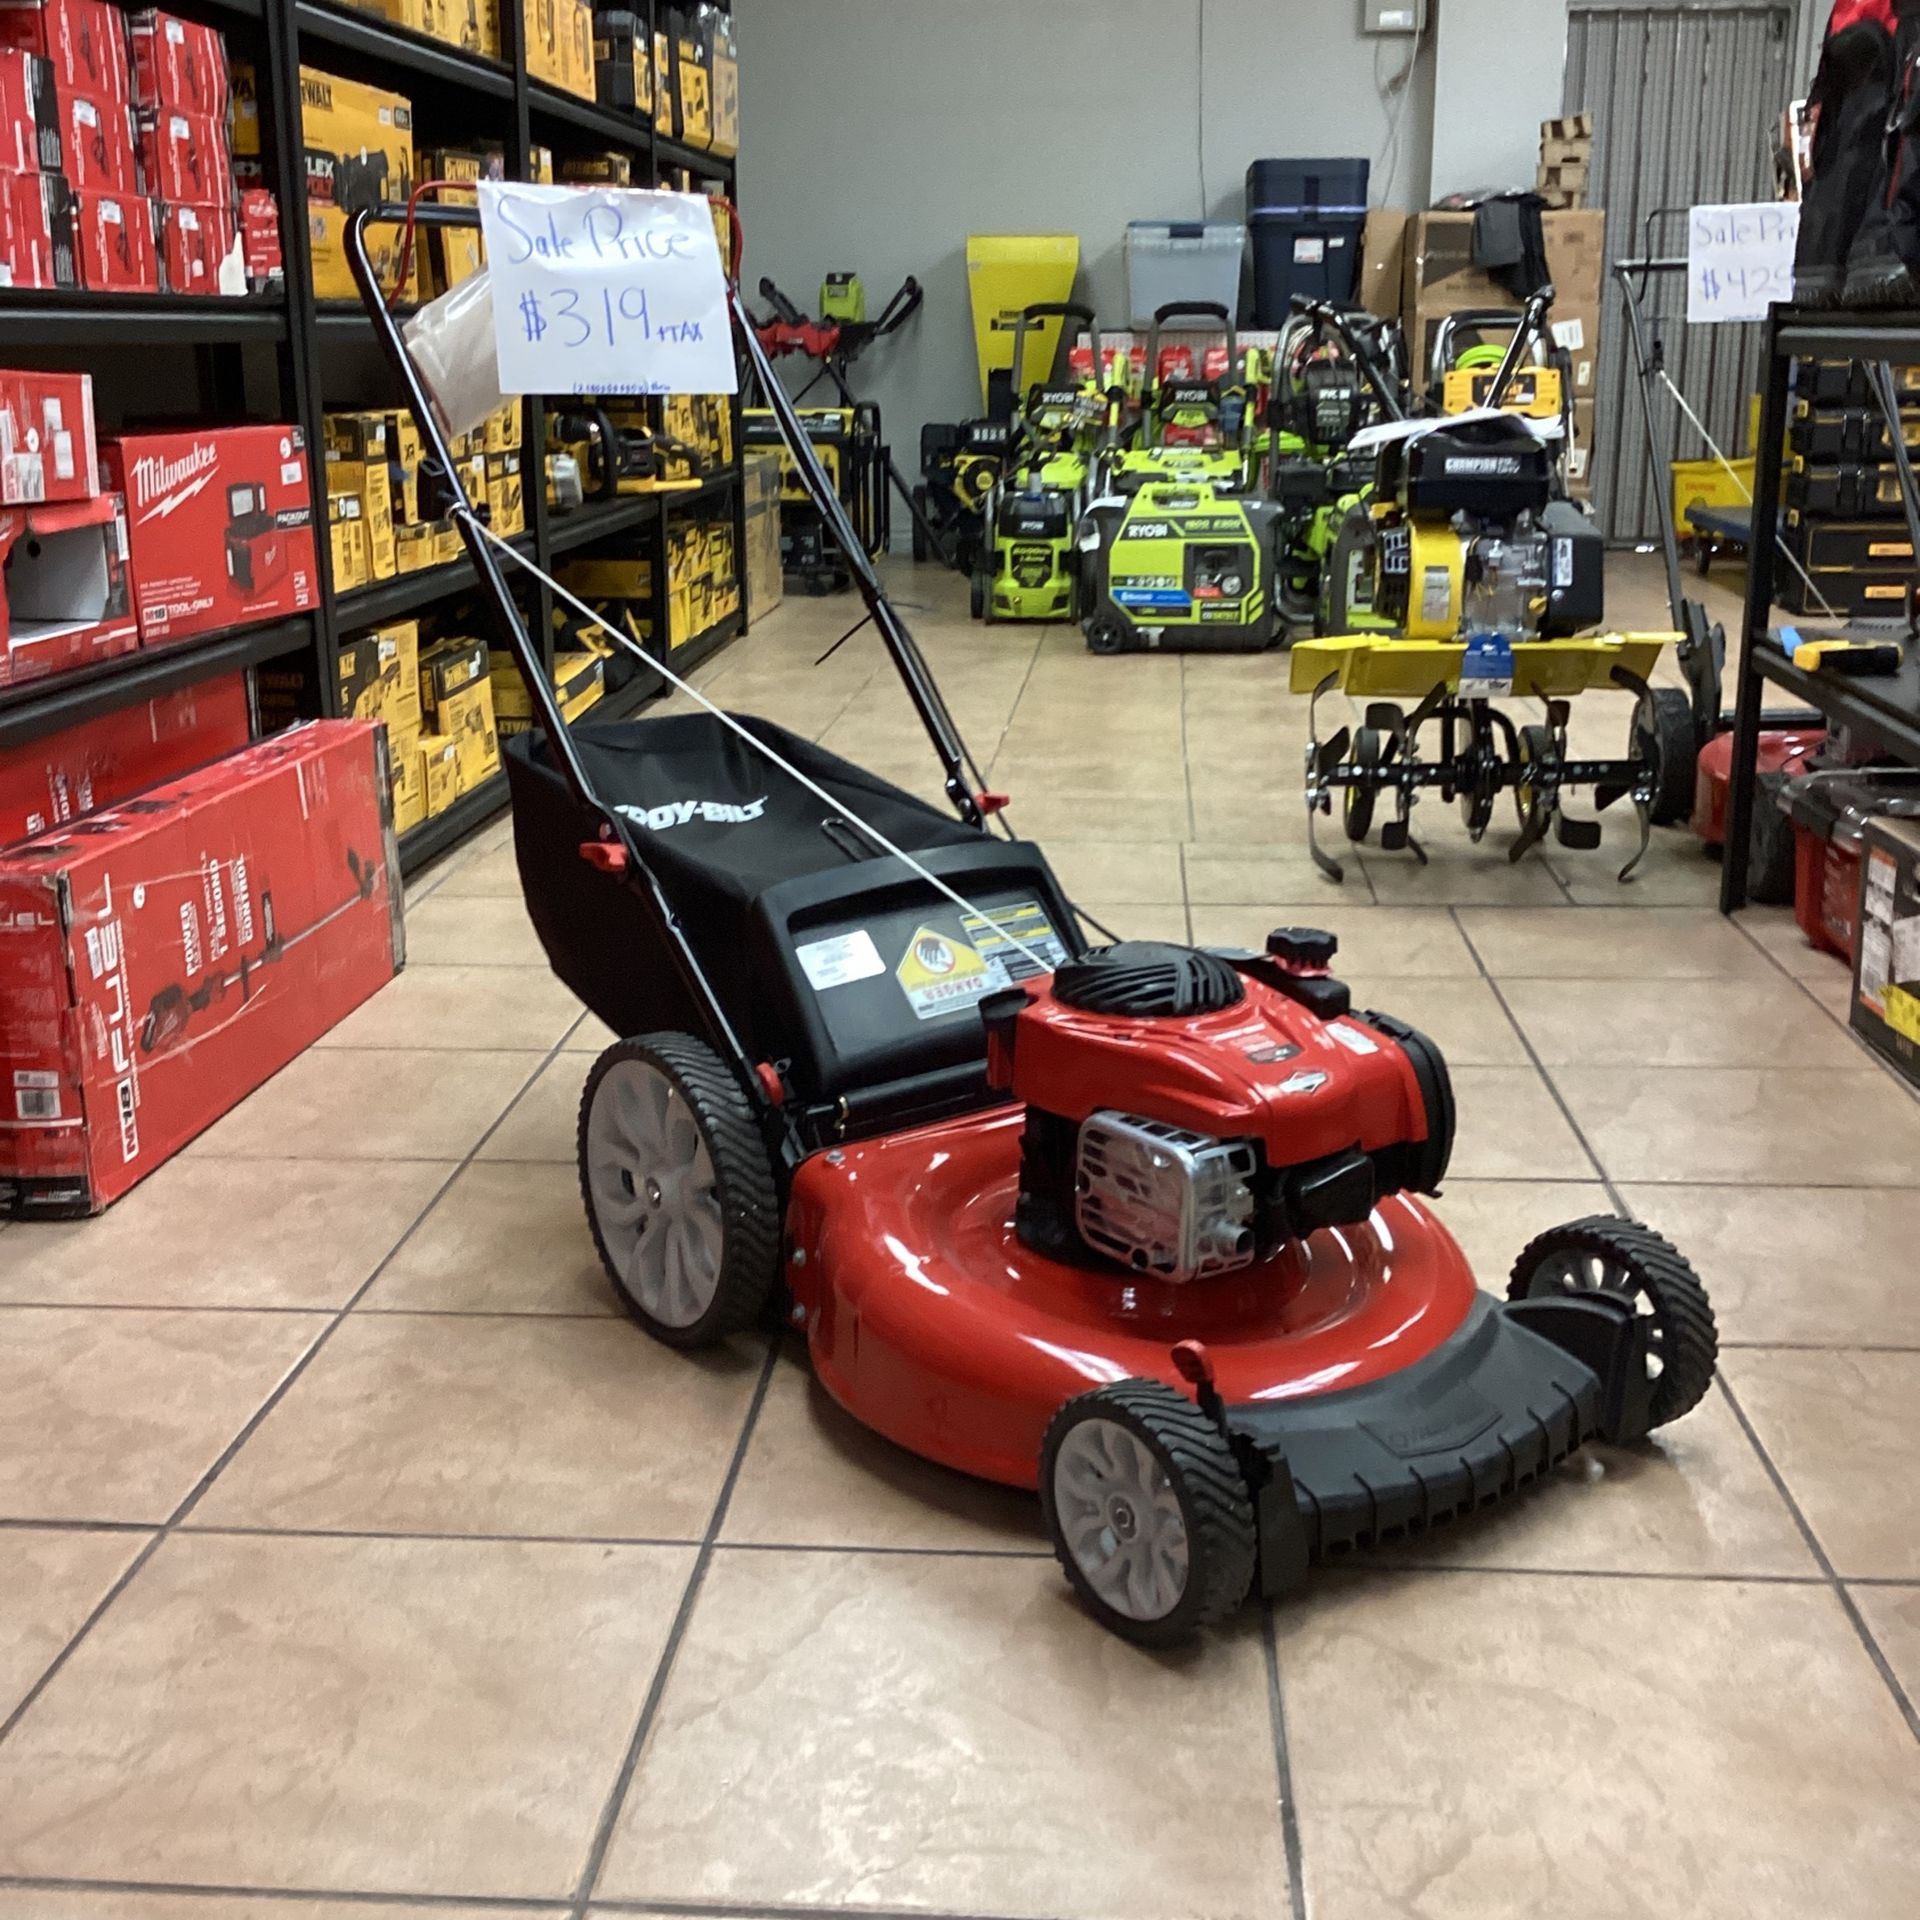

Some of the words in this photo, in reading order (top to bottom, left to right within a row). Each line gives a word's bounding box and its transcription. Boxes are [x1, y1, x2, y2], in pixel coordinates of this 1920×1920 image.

[497, 195, 574, 264] Sale
[583, 204, 698, 261] Price
[1696, 216, 1746, 247] Sale
[519, 286, 651, 347] $319
[656, 322, 704, 344] +TAX
[1042, 391, 1075, 404] RYOBI
[1174, 389, 1208, 401] RYOBI
[130, 441, 218, 508] Milwaukee
[1127, 523, 1168, 538] RYOBI
[209, 858, 226, 938] SECOND
[236, 852, 253, 943] CONTROL
[180, 900, 197, 976] POWER
[98, 872, 129, 1073] FUEL
[119, 1083, 137, 1158] M18
